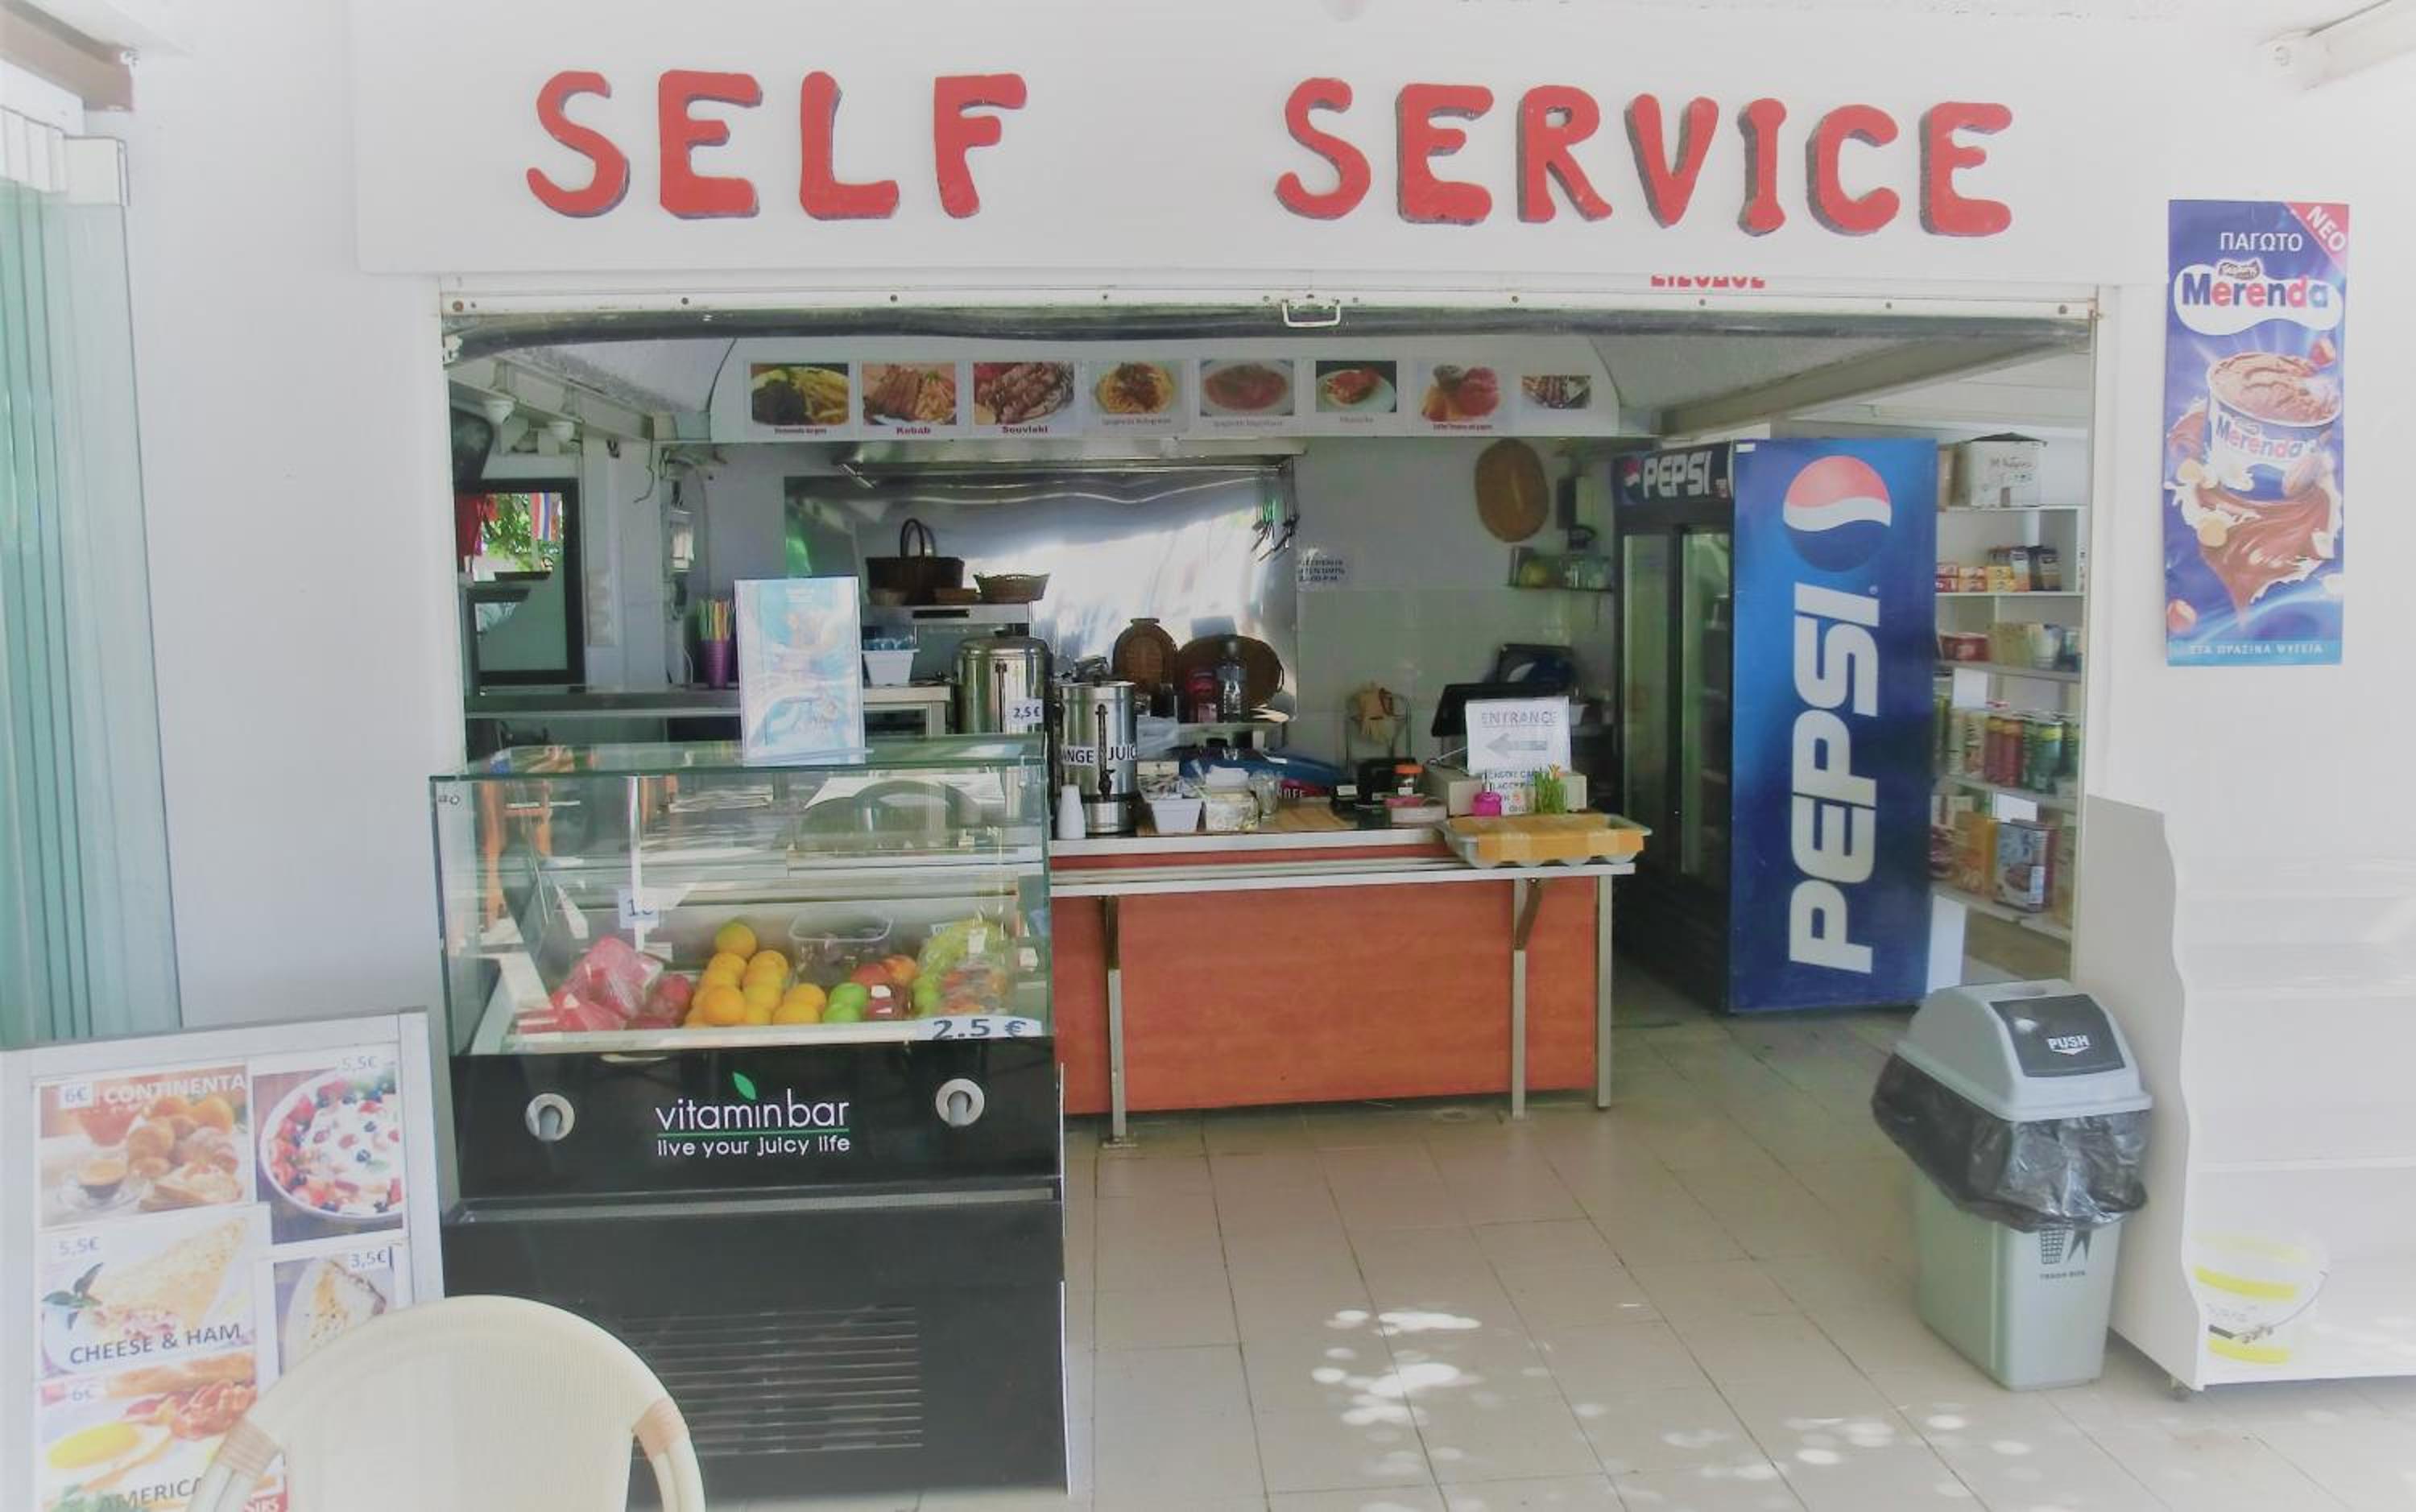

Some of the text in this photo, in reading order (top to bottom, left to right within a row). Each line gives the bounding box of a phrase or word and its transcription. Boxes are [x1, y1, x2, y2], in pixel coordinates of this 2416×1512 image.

[527, 70, 2013, 237] SELF SERVICE
[2219, 232, 2303, 252] ΠΑΓΩΤΟ
[2182, 274, 2328, 308] Merenda
[1644, 451, 1713, 498] PEPSI
[1482, 710, 1559, 725] ENTRANCE
[1789, 582, 1880, 974] PEPSI
[933, 1018, 991, 1041] 2.5
[2047, 1035, 2091, 1050] PUSH
[657, 1139, 696, 1156] live
[702, 1139, 750, 1159] your
[818, 1134, 851, 1152] life
[69, 1323, 241, 1365] CHEESE & HAM
